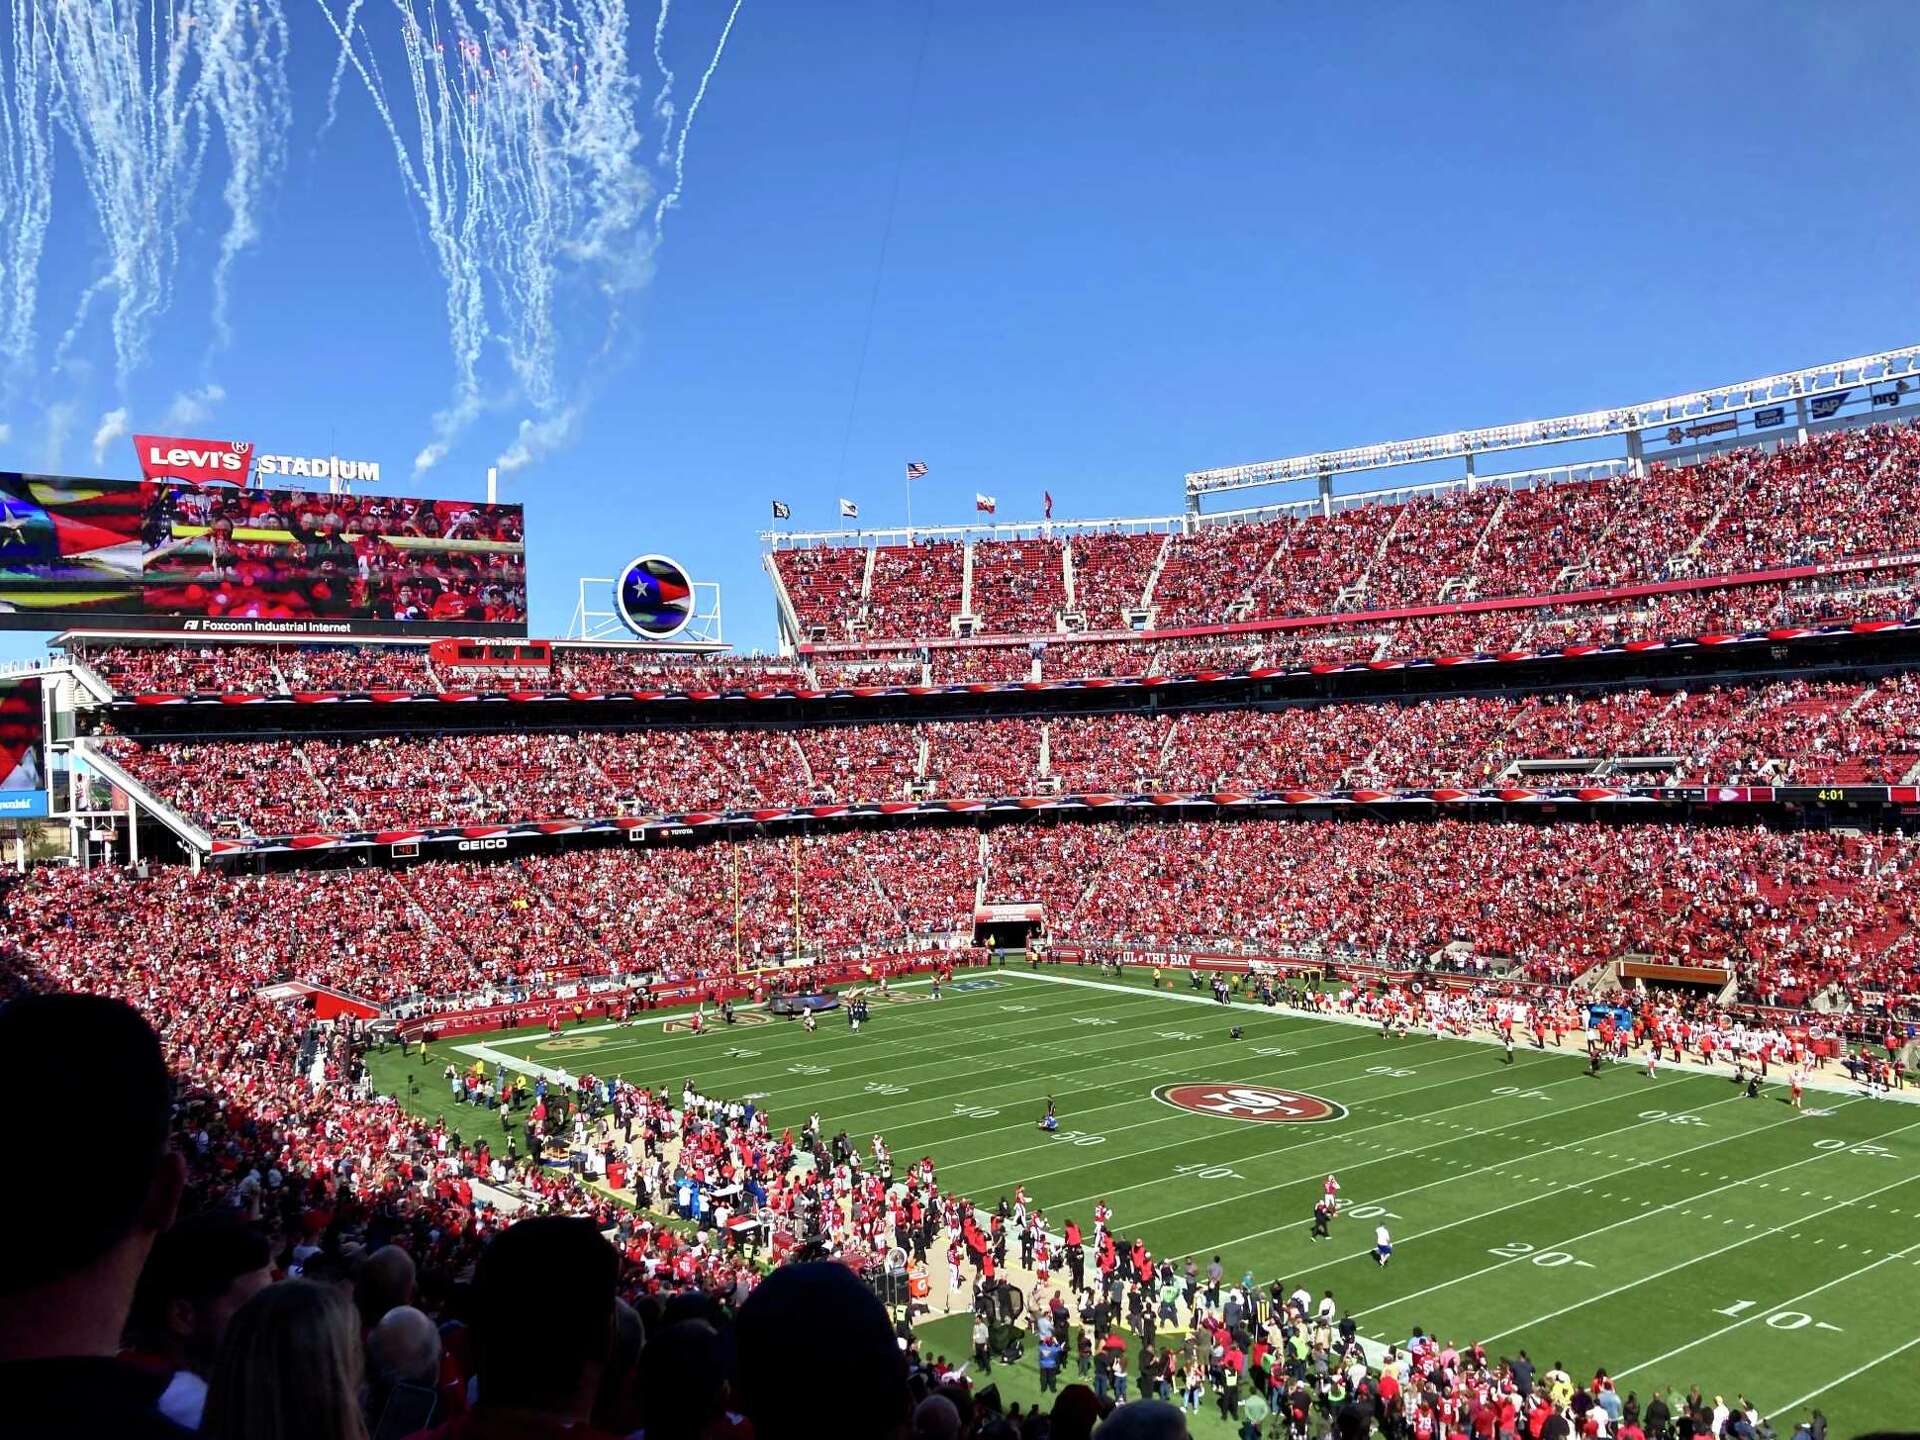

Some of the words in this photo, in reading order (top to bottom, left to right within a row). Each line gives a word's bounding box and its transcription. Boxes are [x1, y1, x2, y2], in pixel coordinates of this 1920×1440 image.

[1812, 400, 1839, 415] SAP
[259, 454, 380, 481] STADIUM
[202, 619, 252, 631] Foxconn
[254, 620, 307, 632] Industrial
[309, 621, 351, 633] Internet
[1818, 789, 1844, 800] 4:01
[458, 838, 508, 851] GEICO
[1145, 952, 1167, 965] THE
[1169, 954, 1192, 966] BAY
[1050, 1130, 1106, 1146] 50
[1487, 1242, 1574, 1267] 20
[1712, 1299, 1813, 1330] 10
